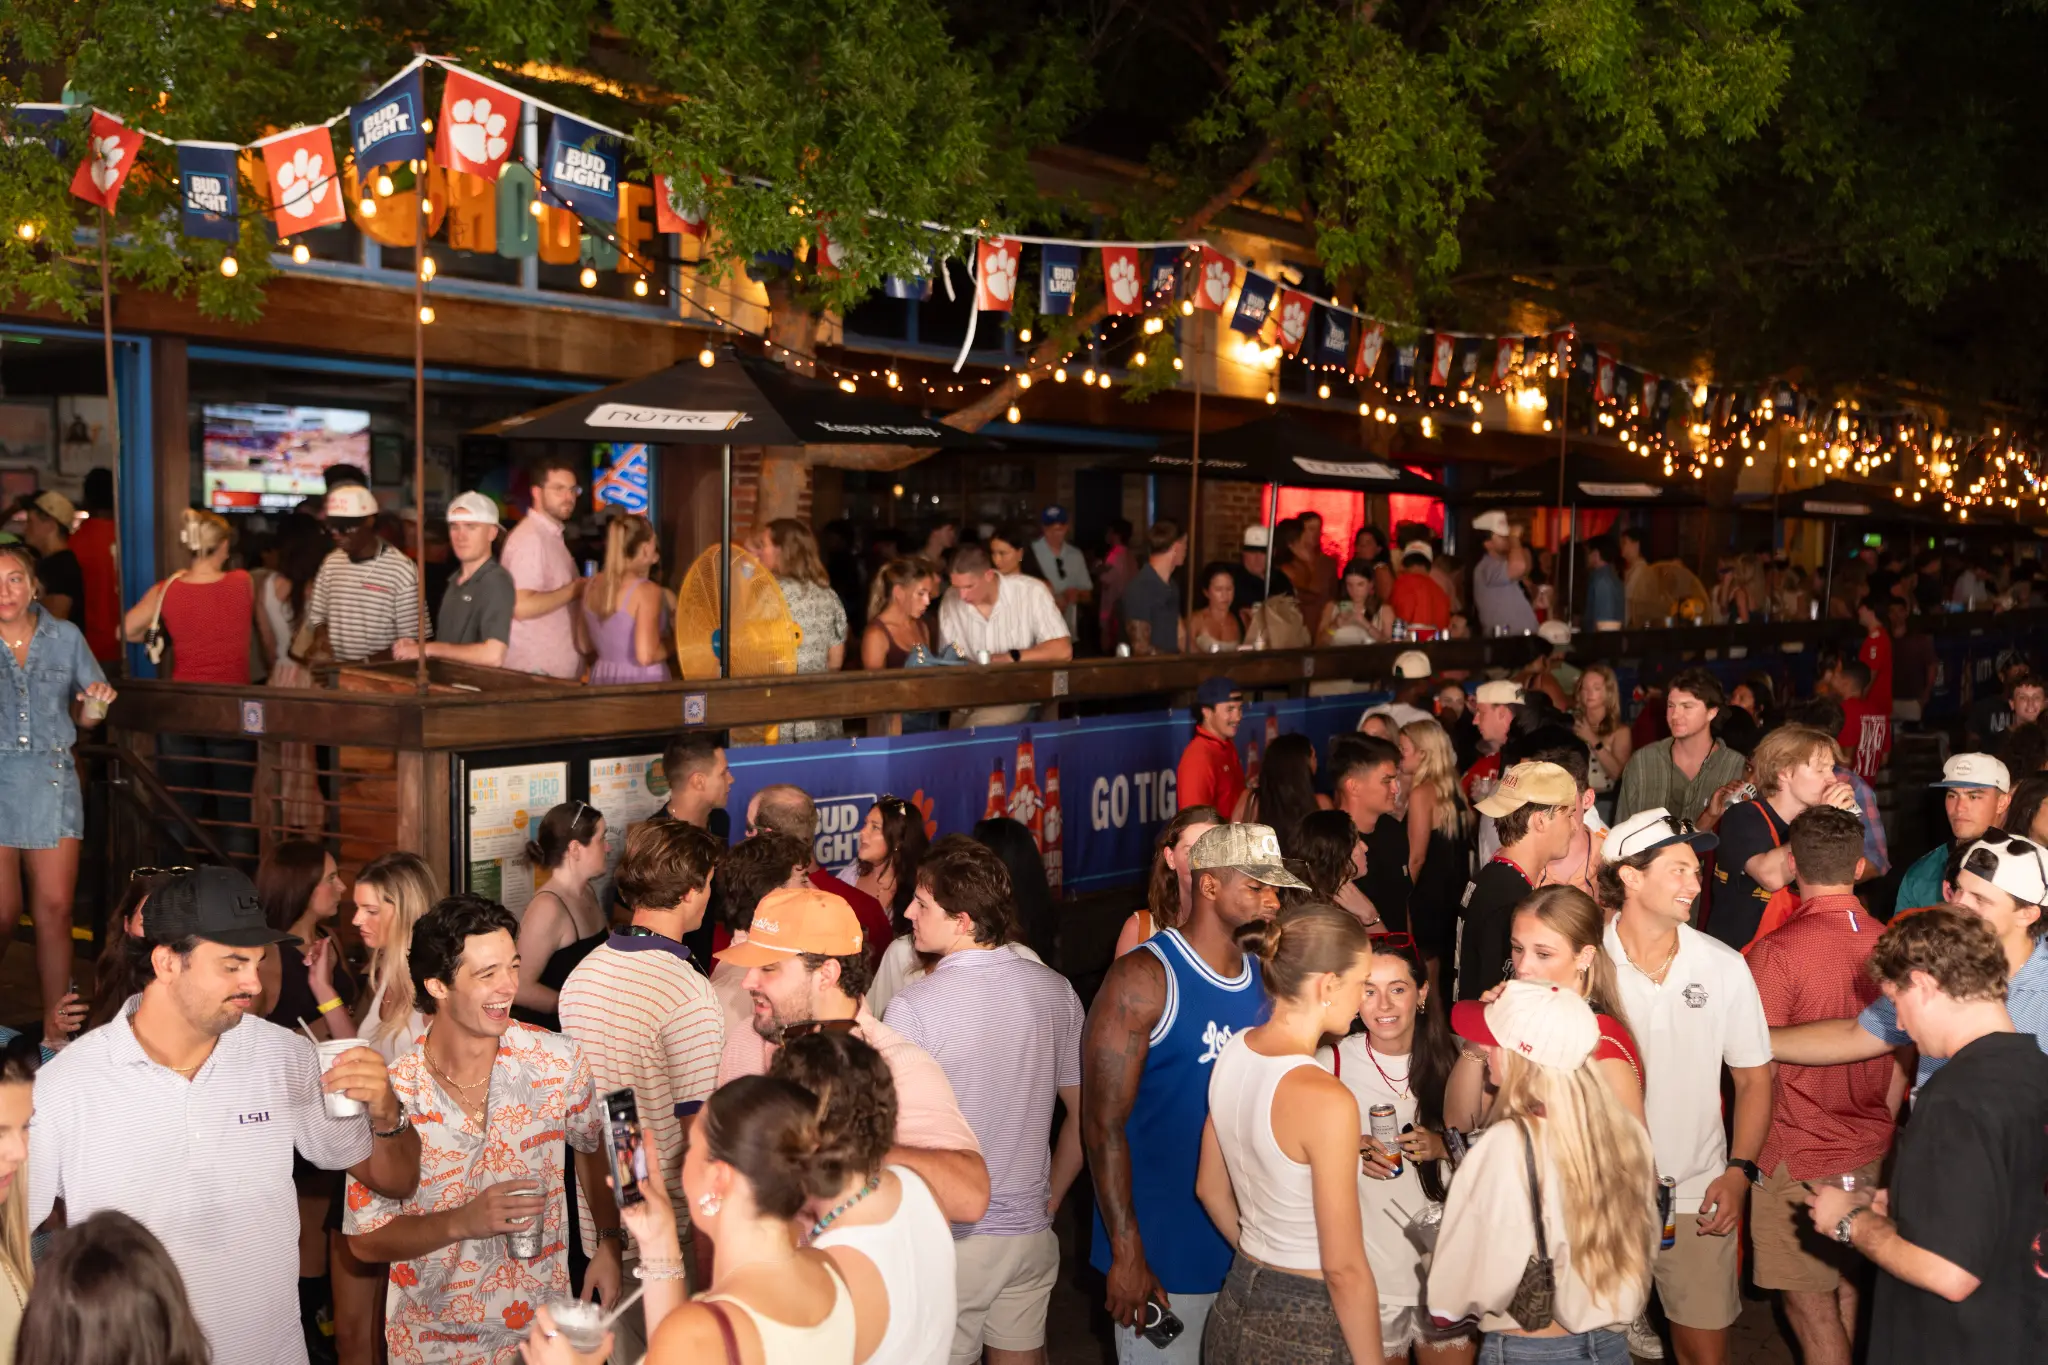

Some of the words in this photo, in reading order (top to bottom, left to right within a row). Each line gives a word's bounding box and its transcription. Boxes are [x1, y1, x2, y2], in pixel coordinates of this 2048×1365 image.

[363, 101, 400, 132] BUD
[358, 112, 411, 154] LIGHT
[566, 146, 606, 174] BUD
[191, 175, 221, 195] BUD
[554, 165, 612, 193] LIGHT
[1053, 266, 1075, 280] BUD
[529, 778, 560, 798] BIRD
[1091, 774, 1129, 831] GO
[238, 1111, 271, 1124] LSU
[431, 1165, 465, 1184] TIGERS!
